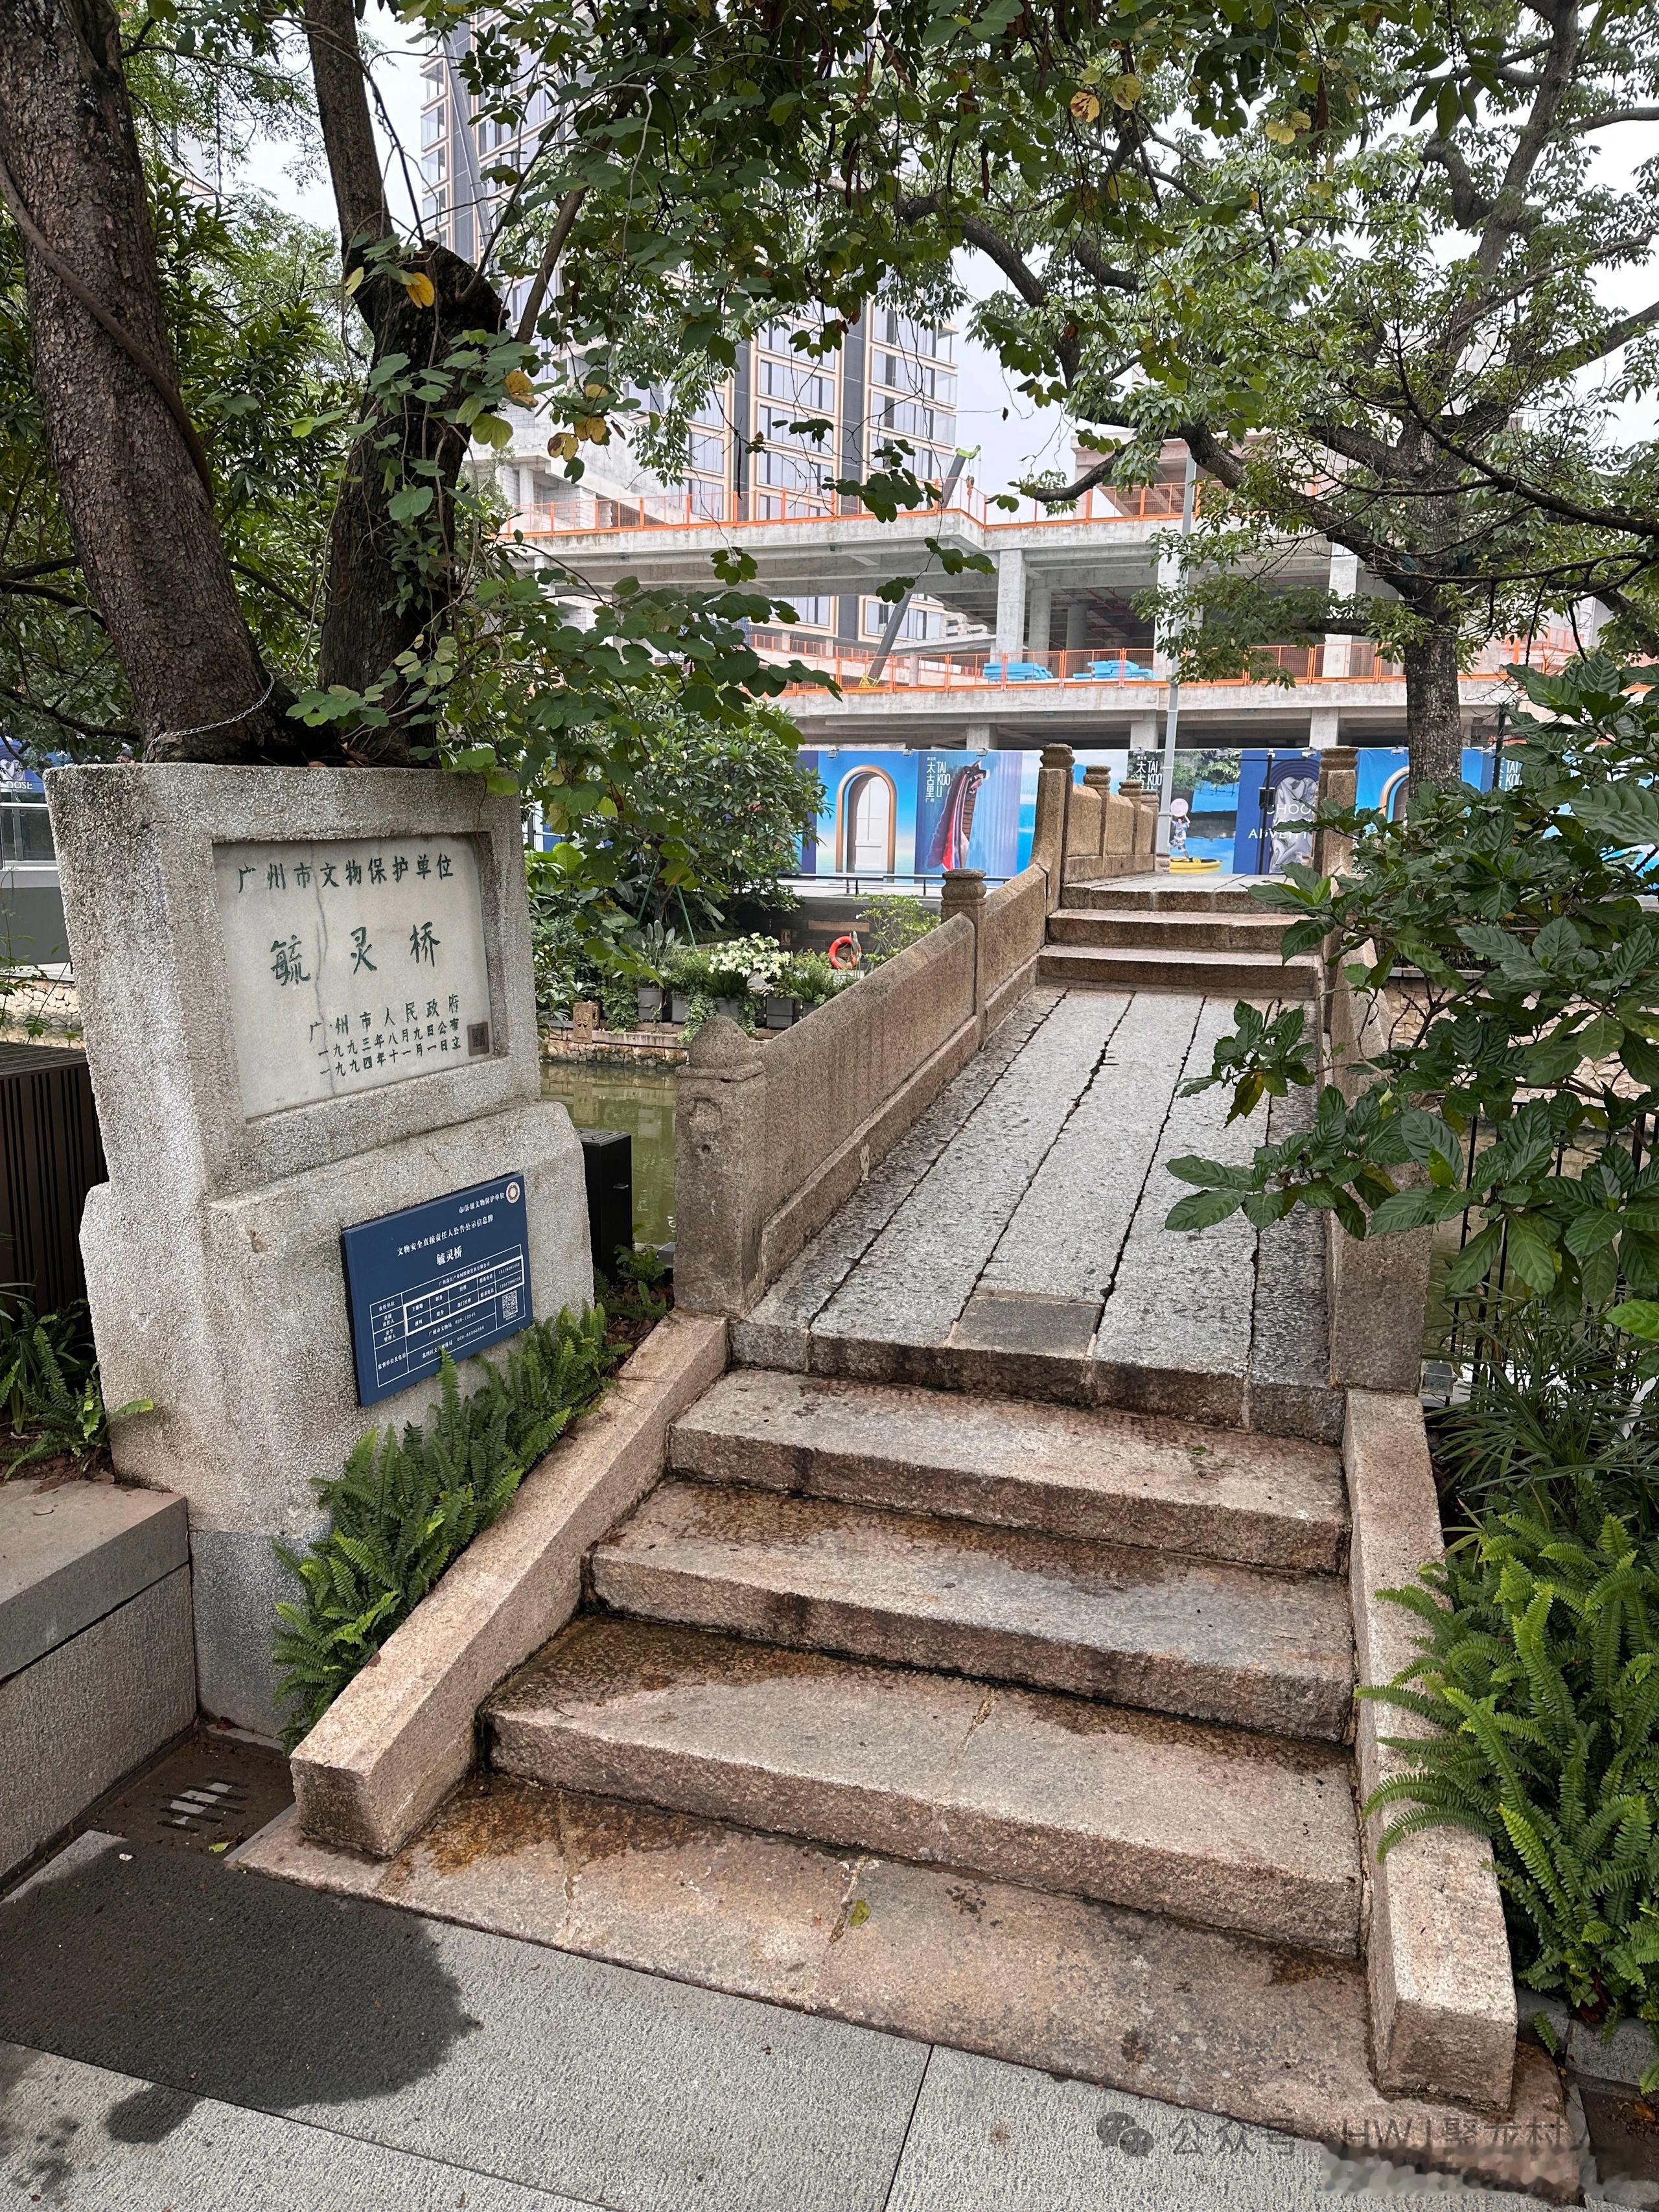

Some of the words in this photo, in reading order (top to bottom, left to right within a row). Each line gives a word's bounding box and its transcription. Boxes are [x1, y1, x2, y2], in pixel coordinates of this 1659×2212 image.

[936, 761, 946, 773] TAI
[1147, 760, 1158, 773] TAI
[1505, 760, 1518, 773] TAI
[6, 781, 33, 789] OOSE
[925, 761, 936, 798] 太古里
[936, 773, 951, 786] KOO
[1147, 773, 1163, 786] KOO
[238, 852, 454, 893] 广州市文物保护单位
[270, 921, 441, 986] 毓灵桥
[309, 994, 459, 1043] 广州市人民政府
[318, 1018, 459, 1058] 一九九三年八月九日公布
[319, 1036, 461, 1077] 一九九四年十一月一日立
[397, 1214, 494, 1257] 文物安全直接责任人公告公示信息牌
[436, 1245, 463, 1266] 毓灵桥
[428, 1321, 452, 1337] 广州市文物局
